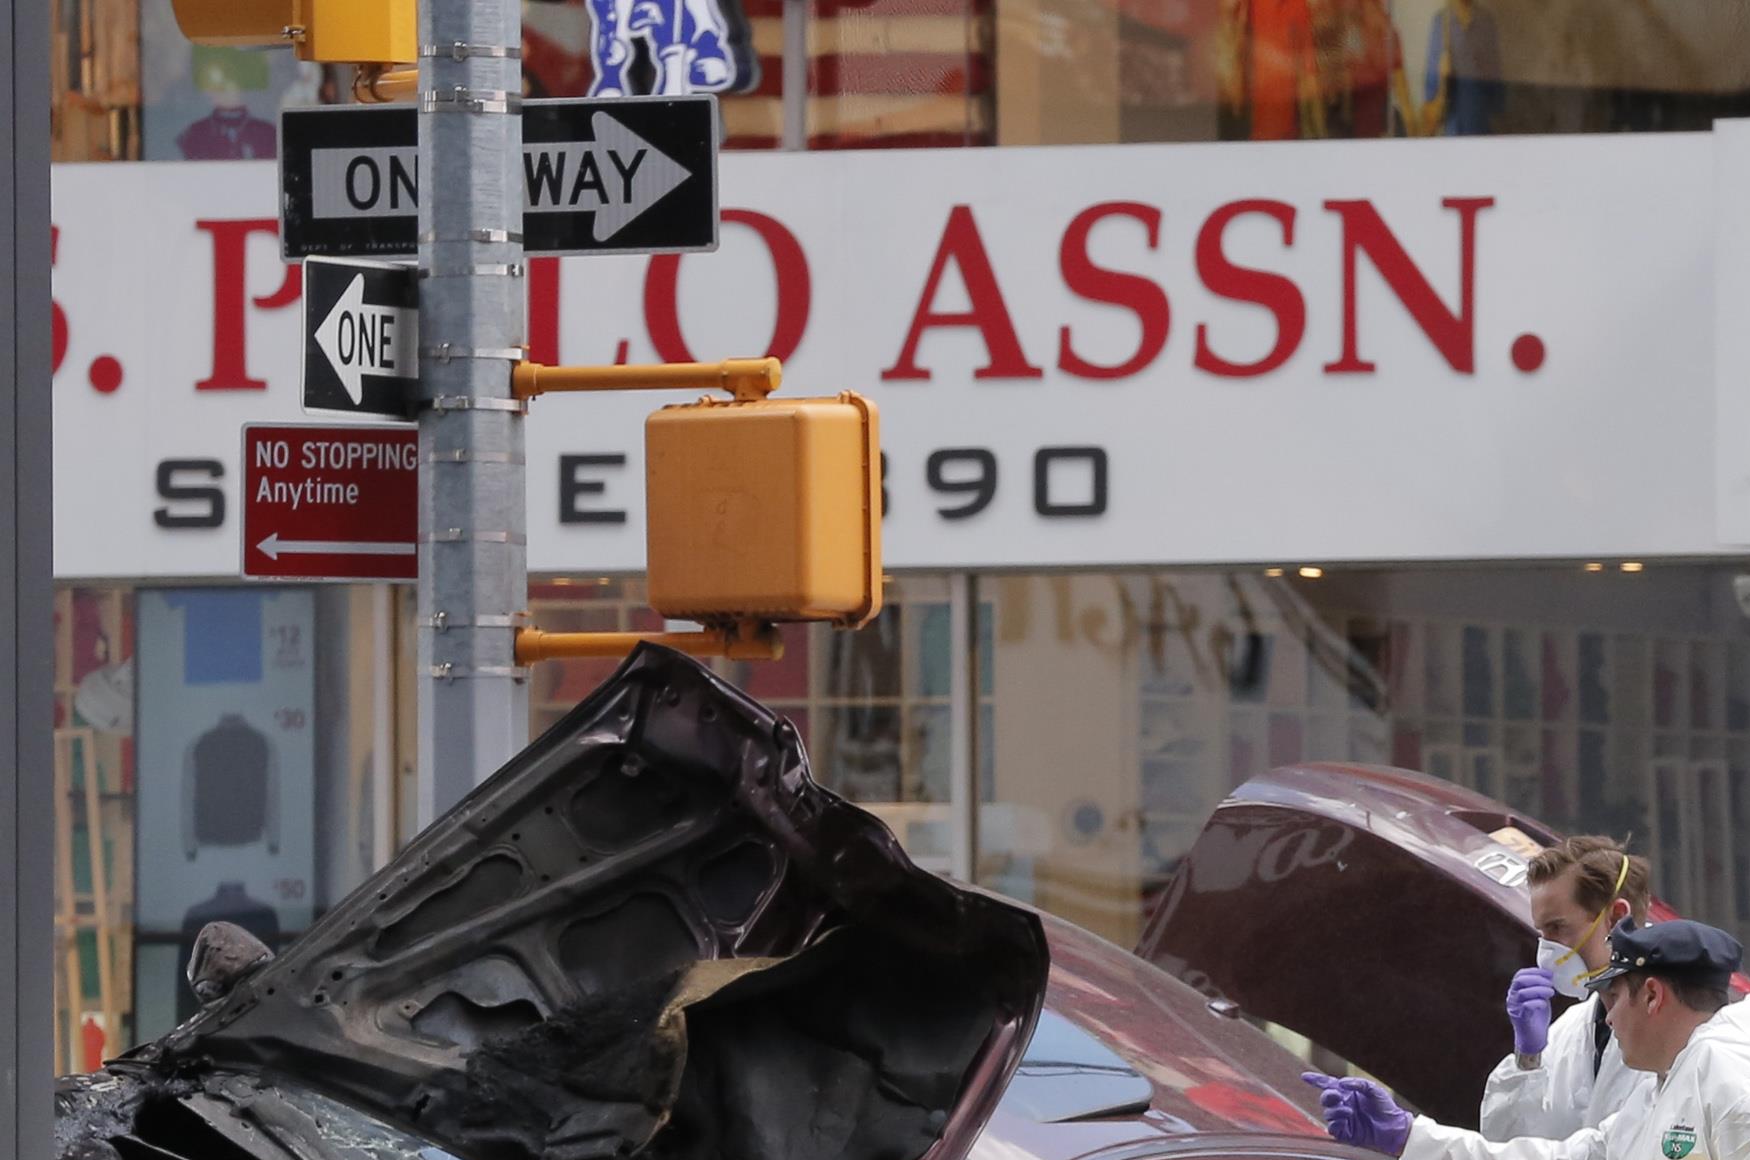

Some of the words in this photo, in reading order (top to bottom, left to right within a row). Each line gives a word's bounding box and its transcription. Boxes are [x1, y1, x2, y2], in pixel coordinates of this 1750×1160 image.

[345, 155, 418, 210] ON
[524, 149, 647, 206] WAY
[881, 197, 1546, 381] ASSN.
[338, 310, 395, 369] ONE
[256, 440, 289, 469] NO
[301, 442, 418, 470] STOPPING
[879, 446, 1108, 519] 90
[256, 476, 359, 510] Anytime
